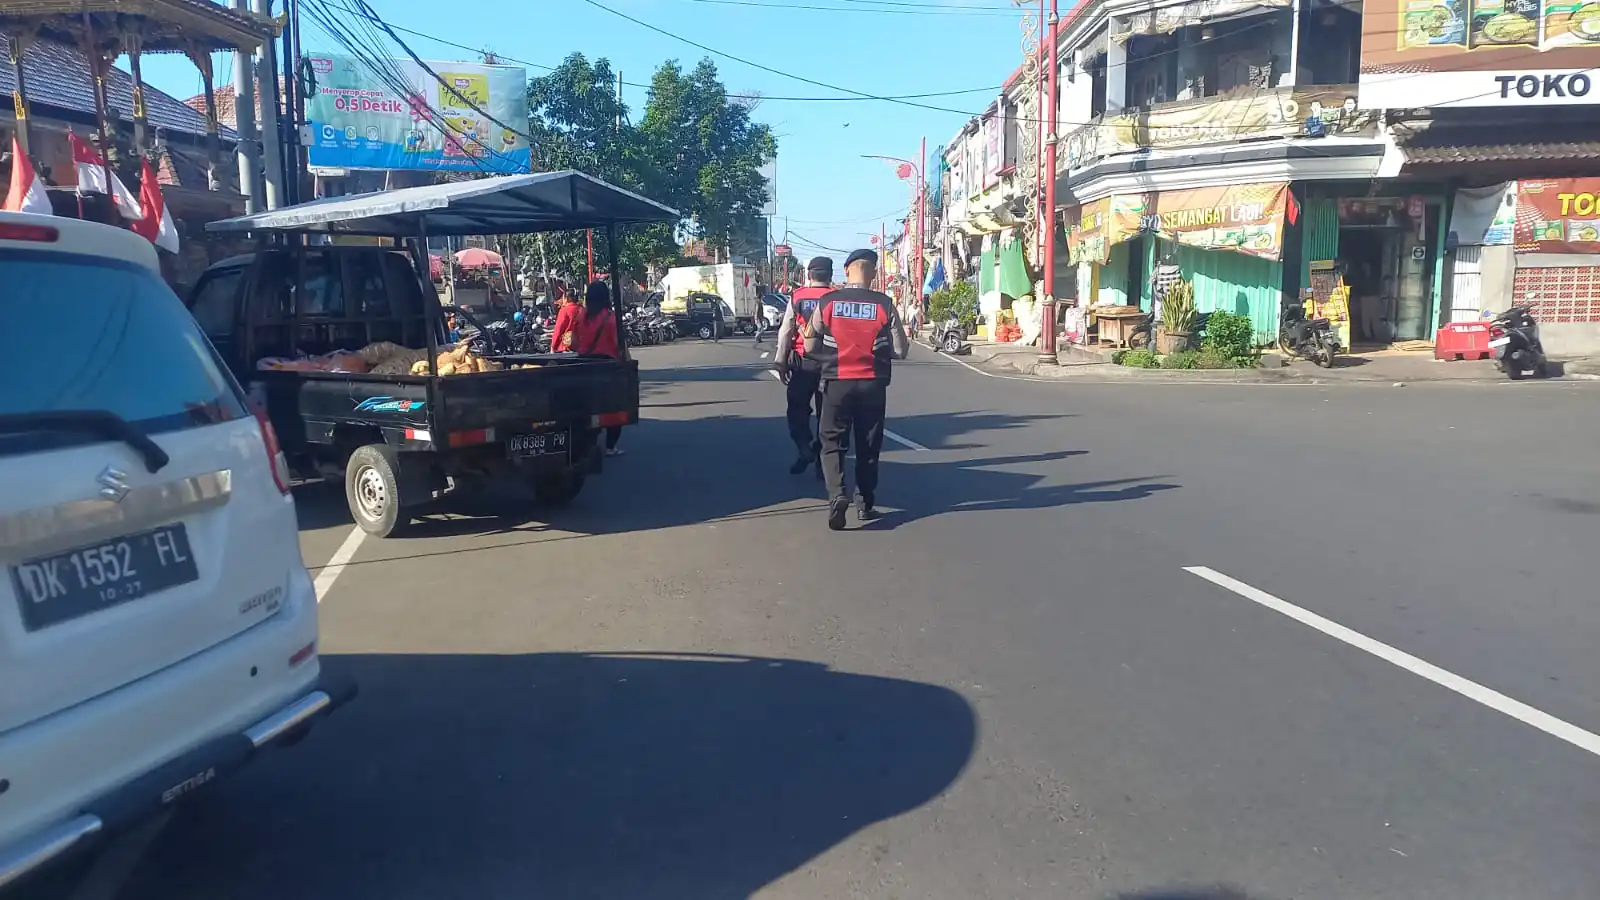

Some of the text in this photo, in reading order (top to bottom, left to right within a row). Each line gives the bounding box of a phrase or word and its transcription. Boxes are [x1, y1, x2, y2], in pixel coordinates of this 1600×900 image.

[1494, 73, 1592, 98] TOKO
[335, 98, 402, 112] 0,5 Detik
[1557, 192, 1600, 216] TO
[1163, 205, 1228, 229] SEMANGAT
[834, 302, 876, 319] POLISI
[21, 530, 187, 604] DK 1552 FL
